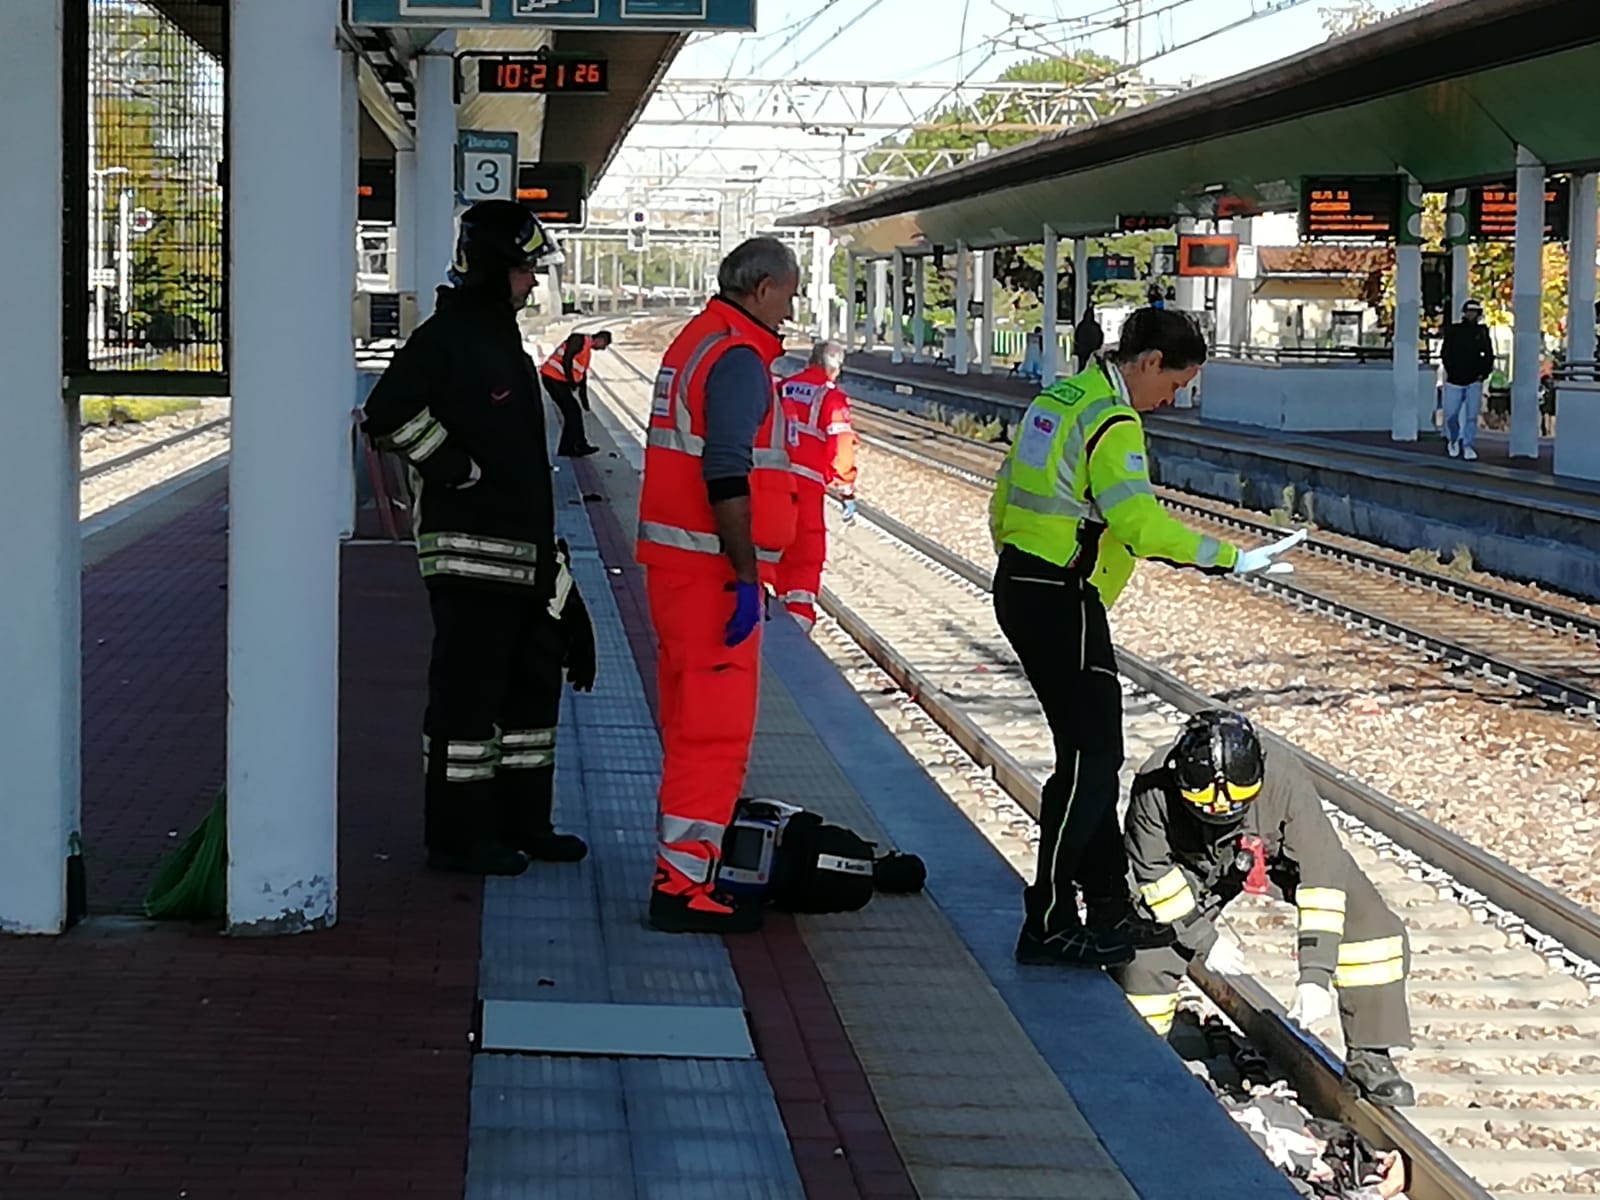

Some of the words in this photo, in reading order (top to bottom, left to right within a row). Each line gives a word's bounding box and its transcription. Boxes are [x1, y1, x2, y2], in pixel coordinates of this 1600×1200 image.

[497, 64, 565, 88] 10:21
[575, 64, 599, 82] 26
[475, 159, 499, 194] 3
